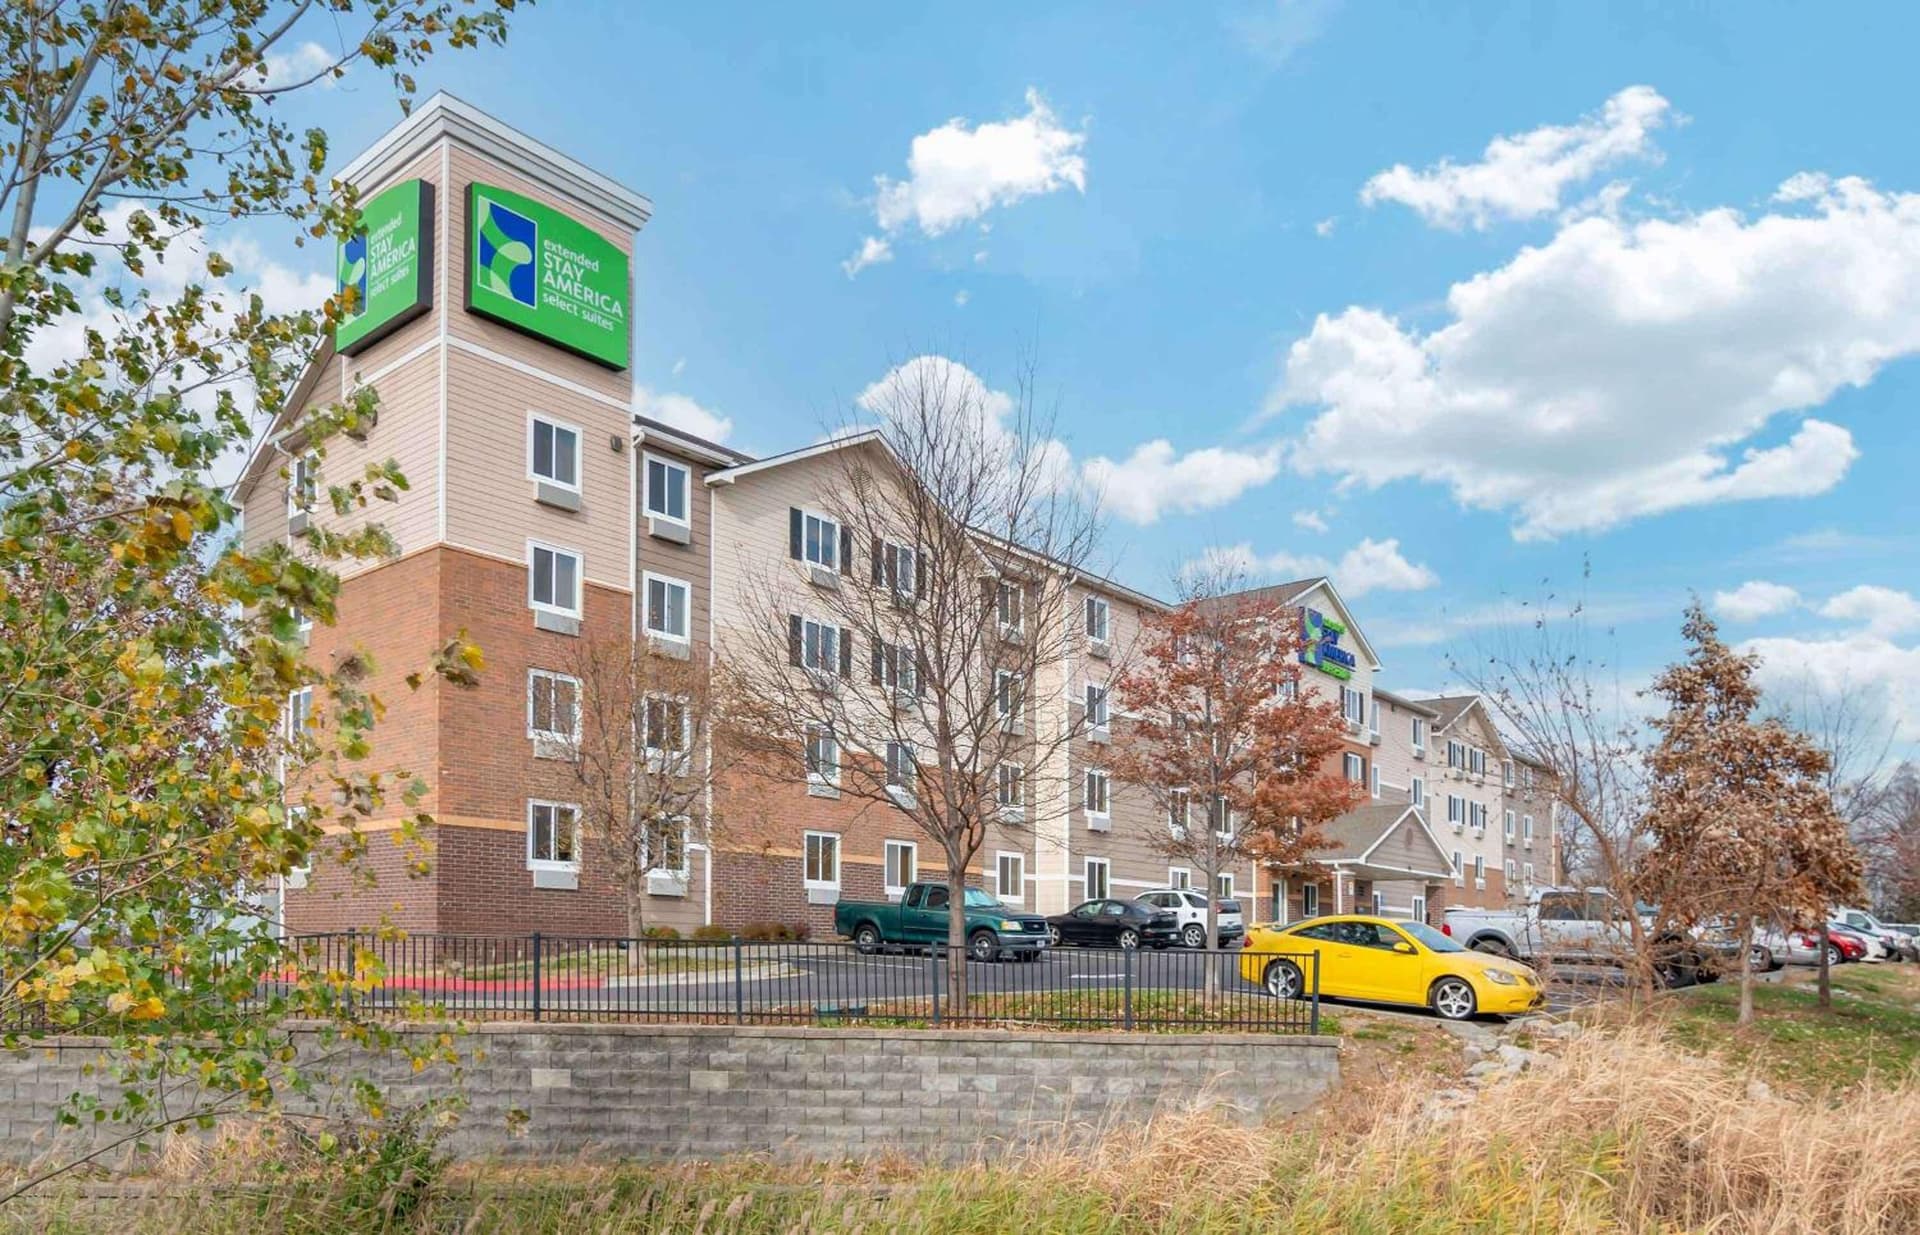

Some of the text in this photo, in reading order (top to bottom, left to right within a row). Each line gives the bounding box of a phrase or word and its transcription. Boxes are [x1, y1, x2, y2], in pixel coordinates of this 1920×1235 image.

[371, 233, 394, 263] STAY
[371, 236, 416, 280] AMERICA
[543, 239, 600, 273] extended
[543, 251, 585, 282] STAY
[542, 270, 624, 318] AMERICA
[543, 293, 614, 331] select suites
